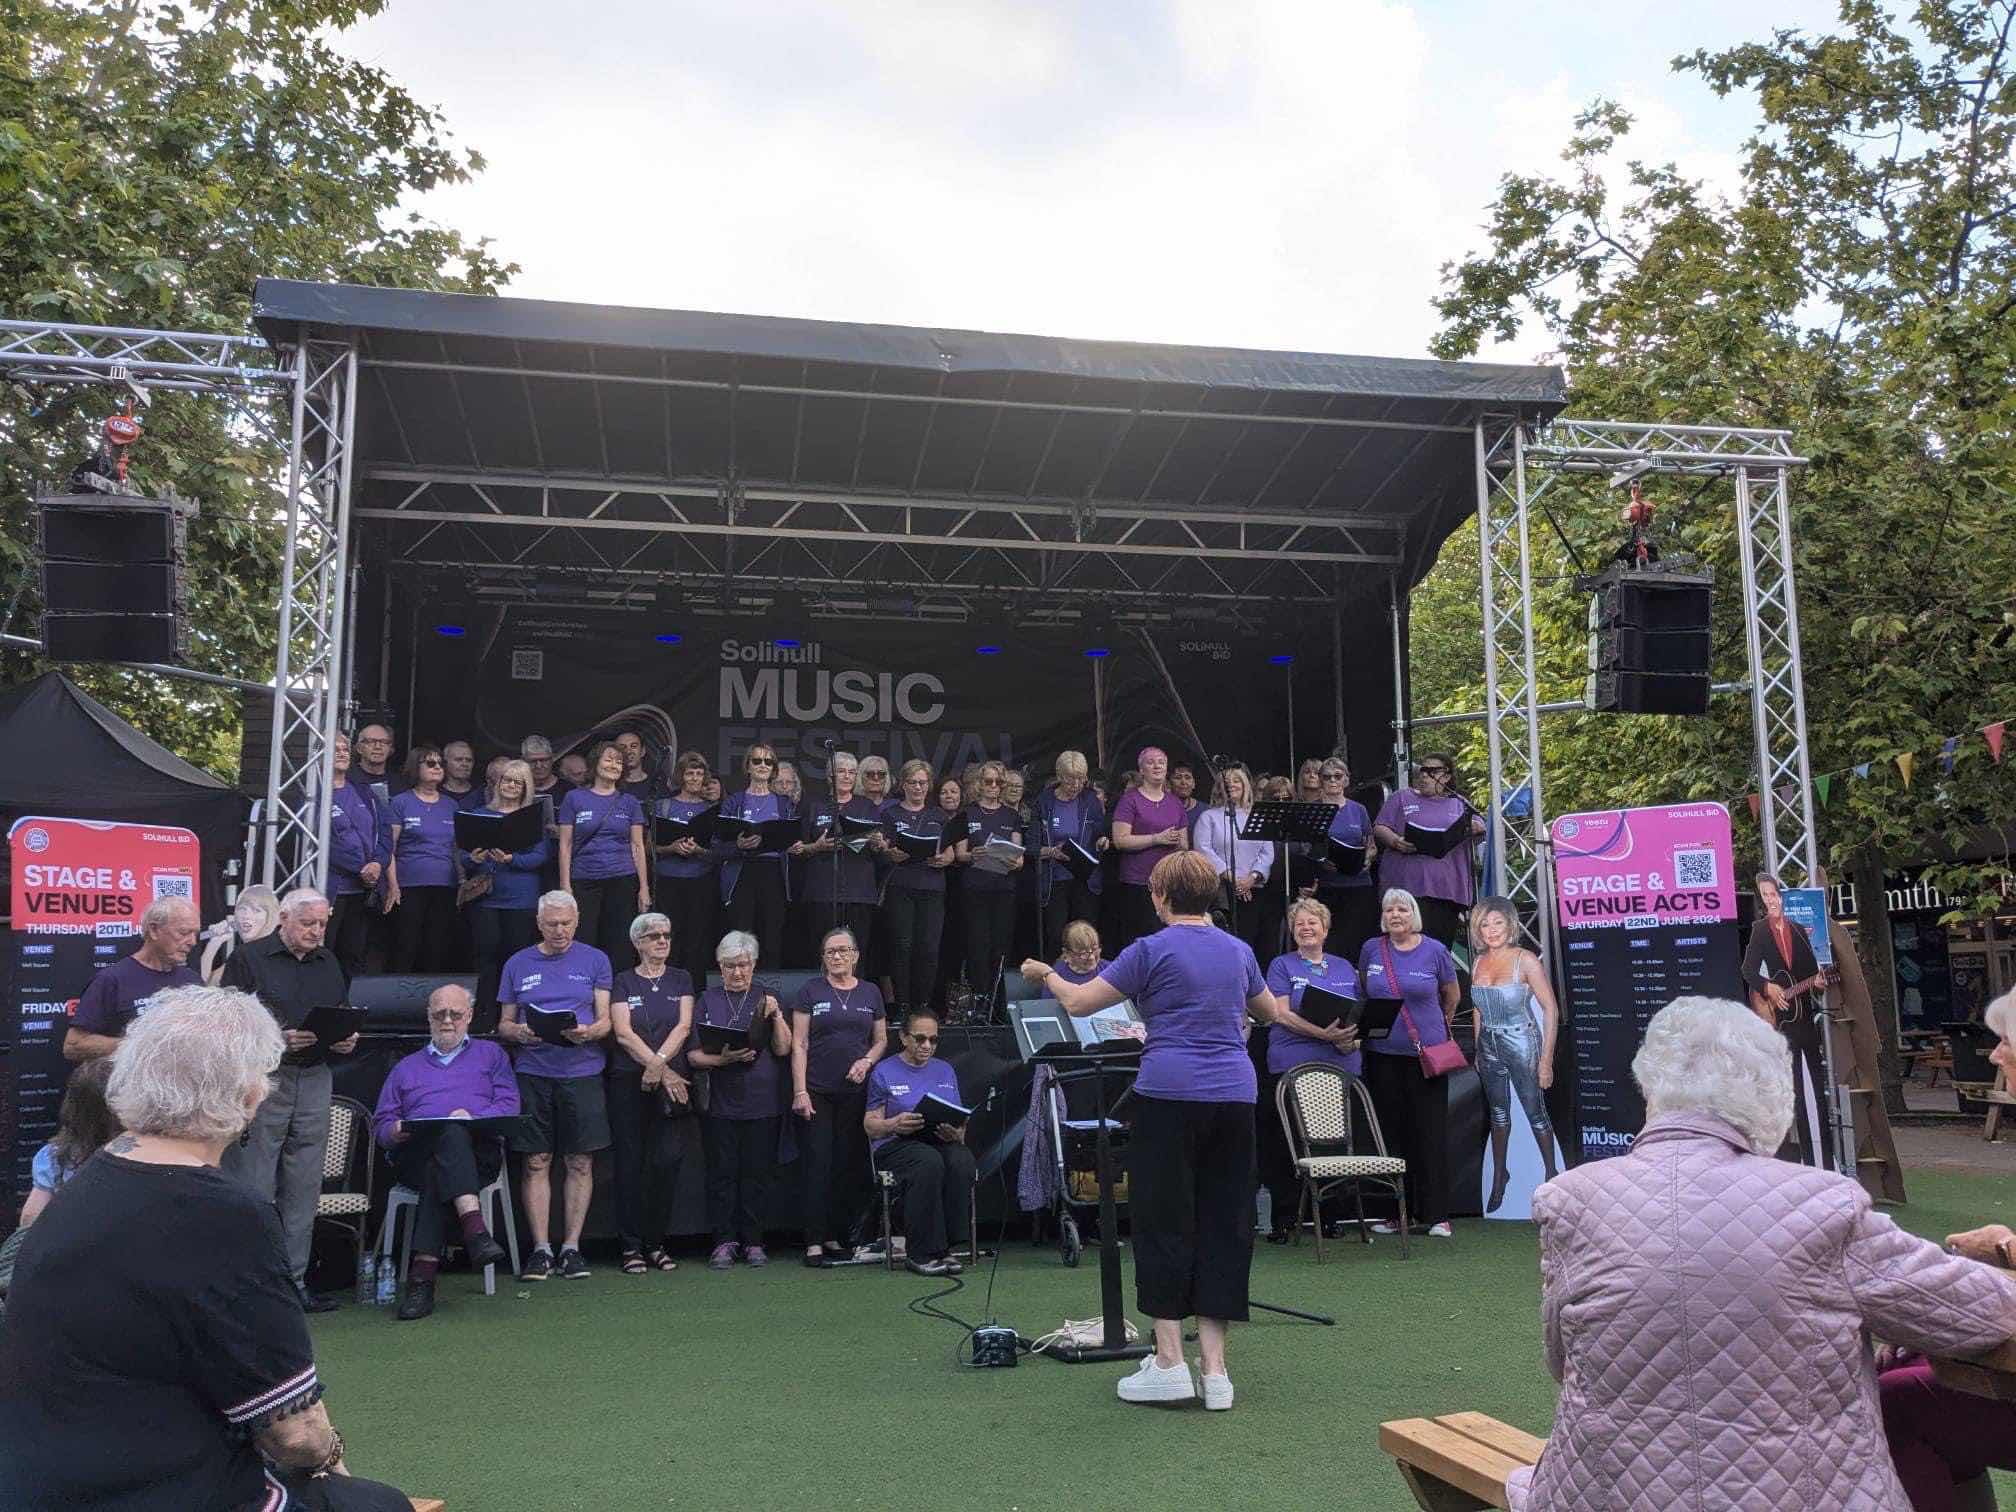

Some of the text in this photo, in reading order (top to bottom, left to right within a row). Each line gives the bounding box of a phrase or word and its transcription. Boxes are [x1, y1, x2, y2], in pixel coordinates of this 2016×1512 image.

[720, 638, 822, 664] Solihull
[719, 666, 945, 725] MUSIC
[24, 864, 137, 890] STAGE &
[1563, 872, 1666, 896] STAGE &
[24, 891, 134, 915] VENUES
[1564, 891, 1721, 917] VENUE ACTS
[25, 922, 93, 935] THURSDAY
[97, 923, 131, 937] 20TH
[1567, 914, 1721, 930] SATURDAY 22ND JUNE 2024
[24, 945, 52, 954] VENUE
[21, 1002, 68, 1015] FRIDAY
[23, 1020, 51, 1030] VENUE
[1583, 1132, 1634, 1146] MUSIC
